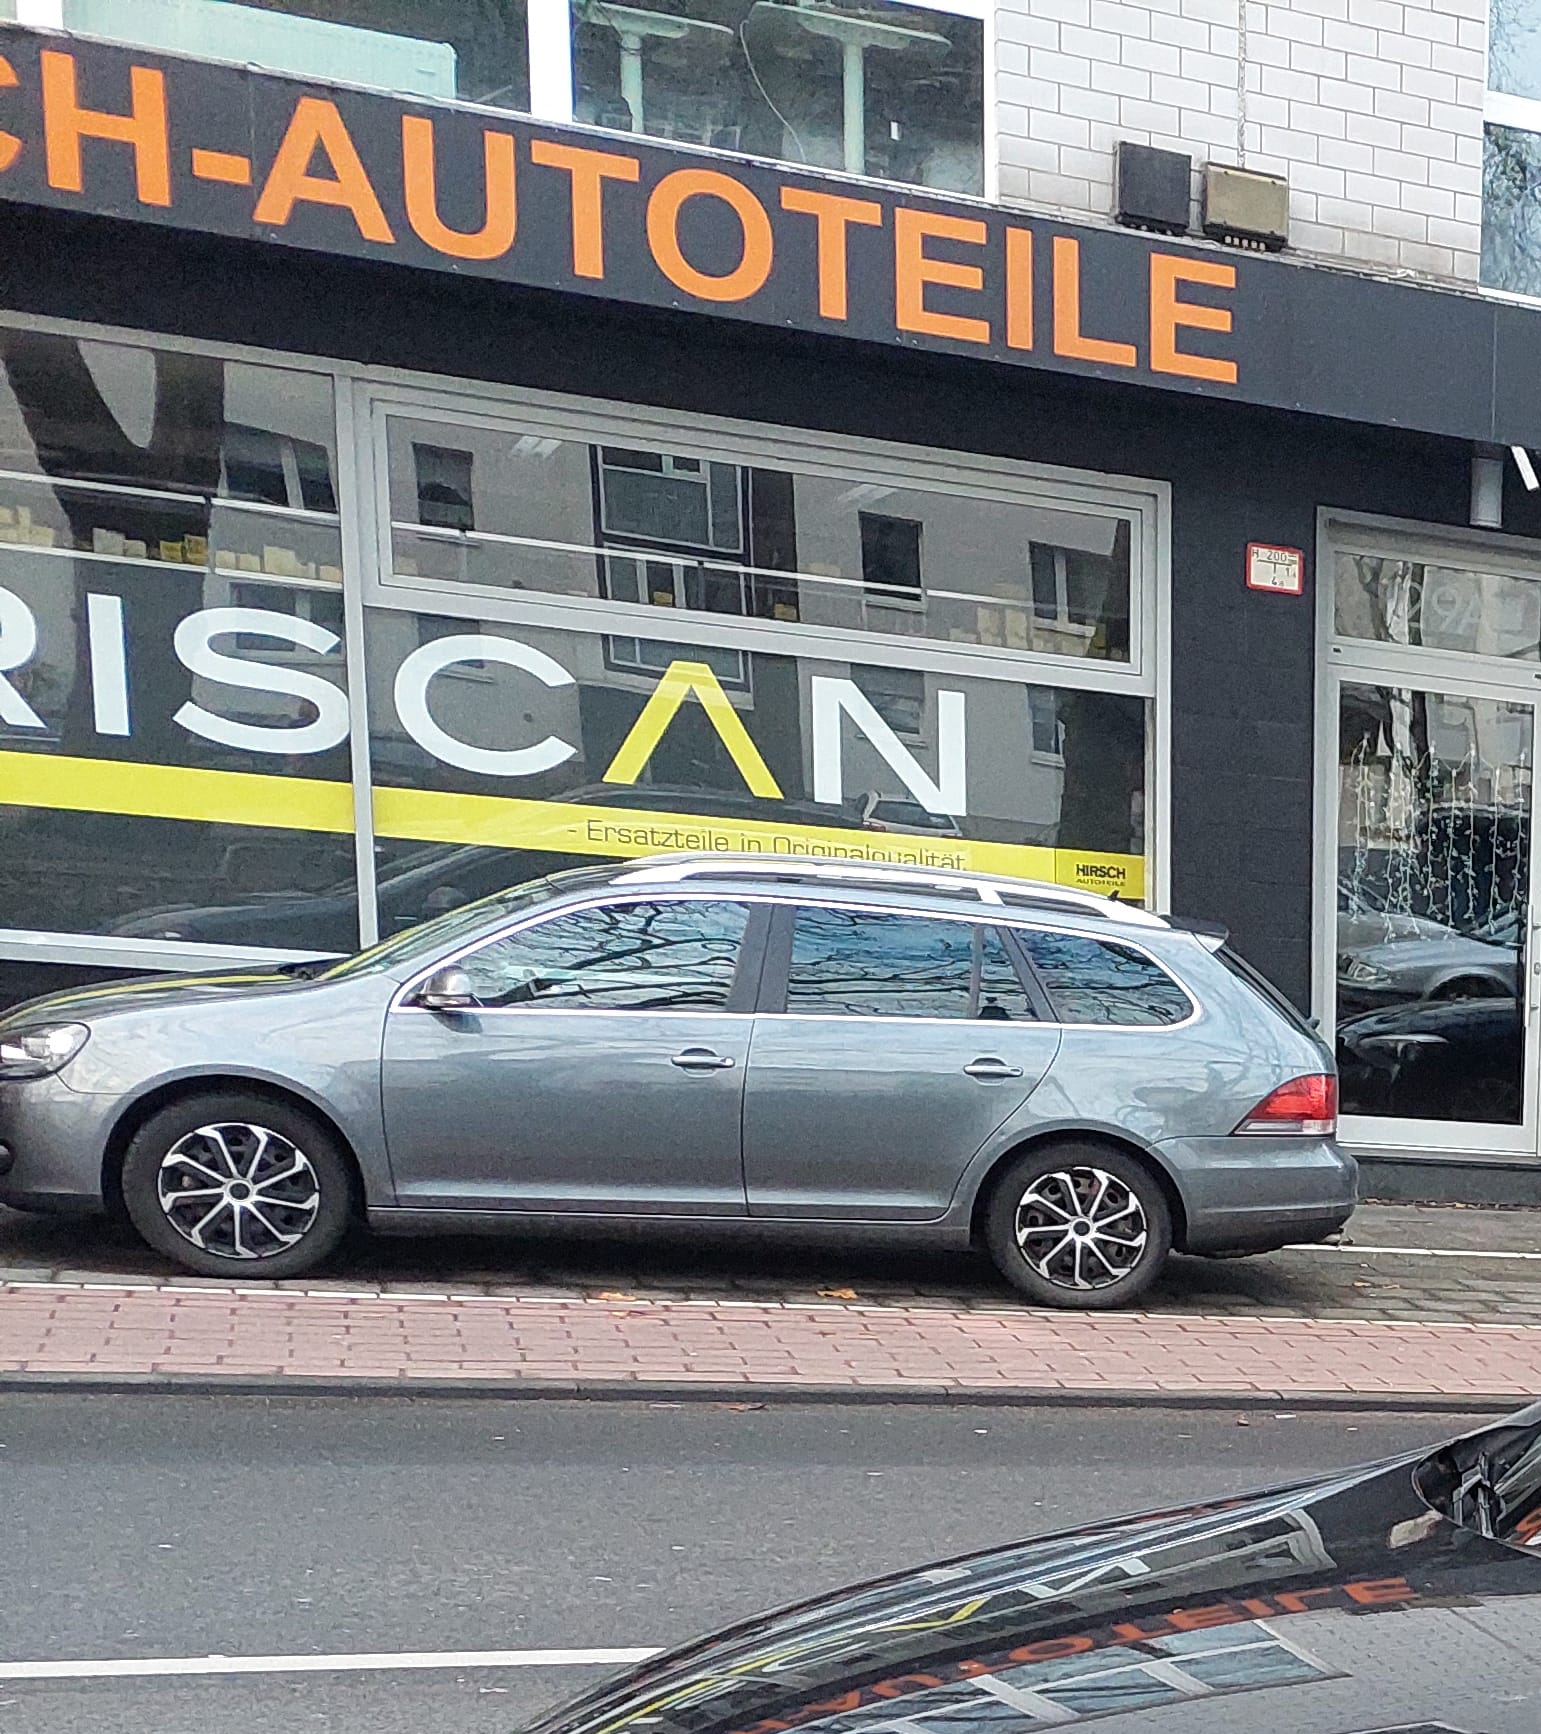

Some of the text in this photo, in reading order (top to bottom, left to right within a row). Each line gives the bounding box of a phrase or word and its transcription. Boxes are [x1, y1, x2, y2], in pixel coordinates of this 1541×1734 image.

[0, 50, 1239, 384] H-AUTOTEILE
[586, 819, 730, 852] Ersatzteile
[740, 832, 763, 853] in
[1076, 863, 1127, 880] HIRSCH
